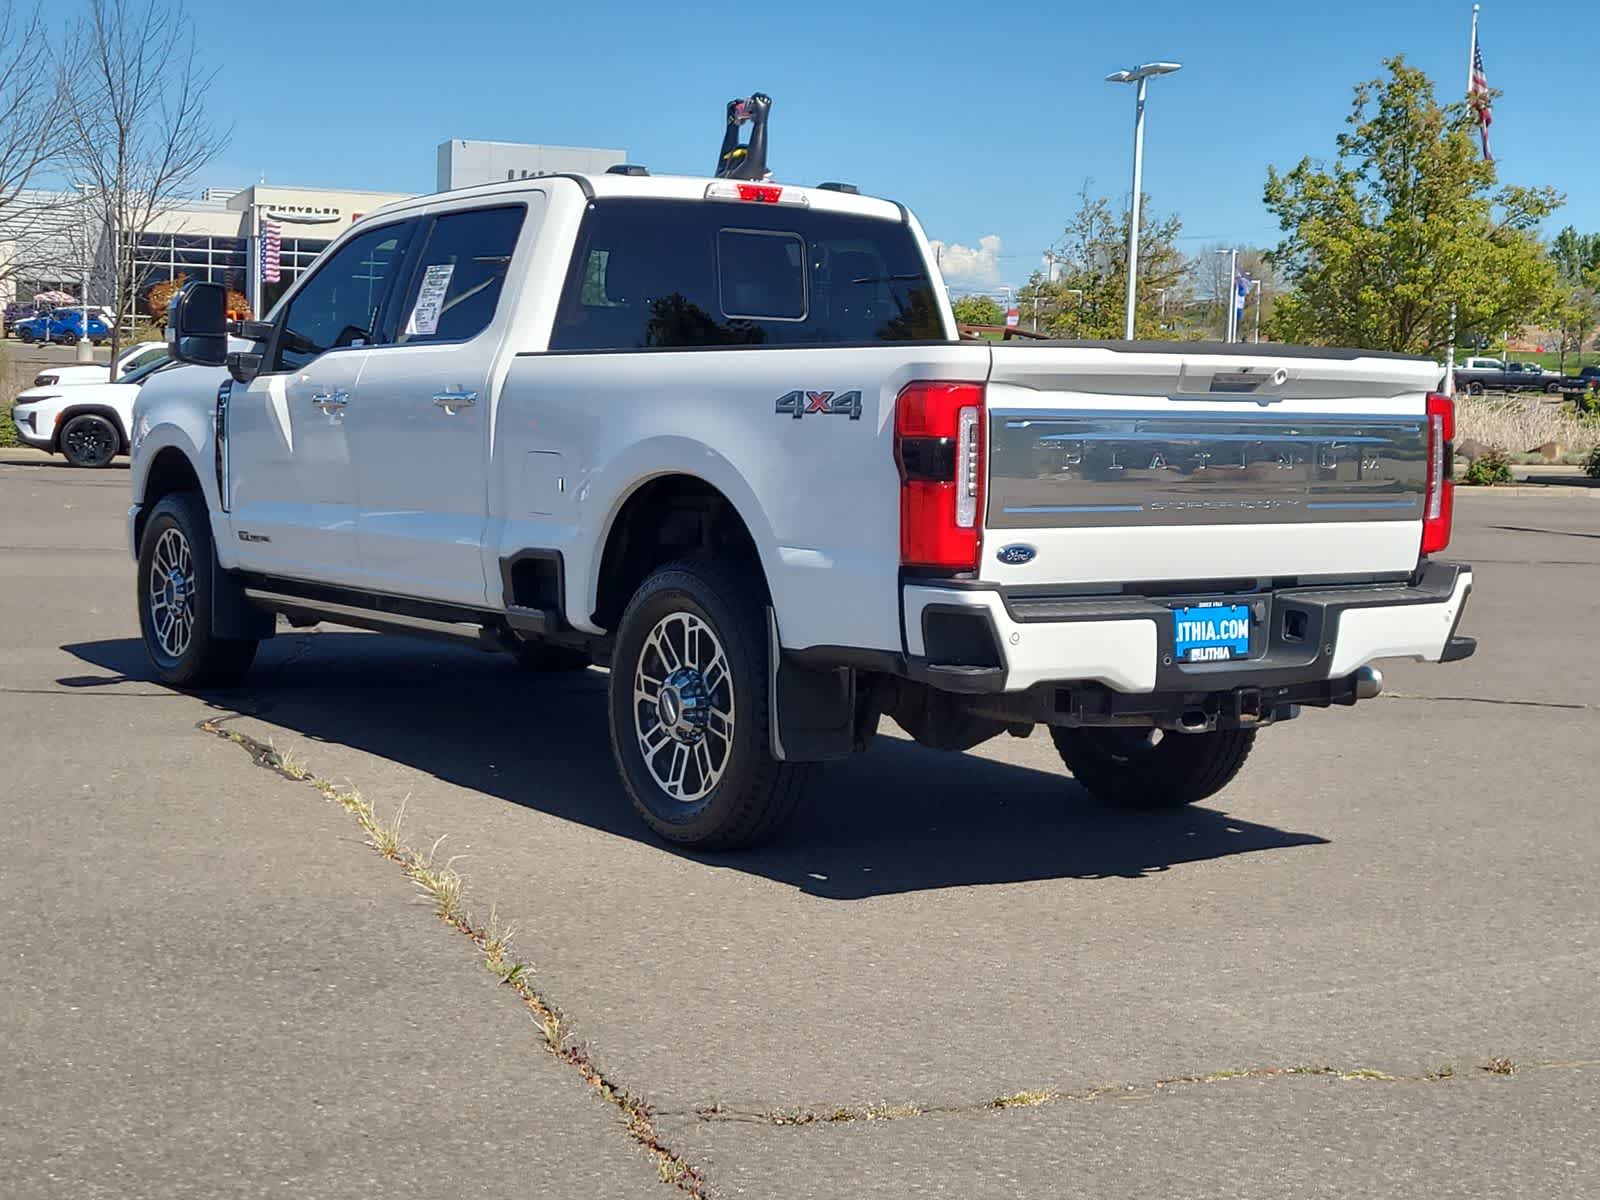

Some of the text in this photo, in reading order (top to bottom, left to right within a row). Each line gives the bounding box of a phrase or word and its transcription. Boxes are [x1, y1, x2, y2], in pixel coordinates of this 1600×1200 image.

[269, 205, 340, 215] CHRYSLER
[1061, 450, 1381, 470] PLATINUM
[1176, 619, 1249, 642] ITHIA.COM
[1200, 647, 1230, 660] LITHIA
